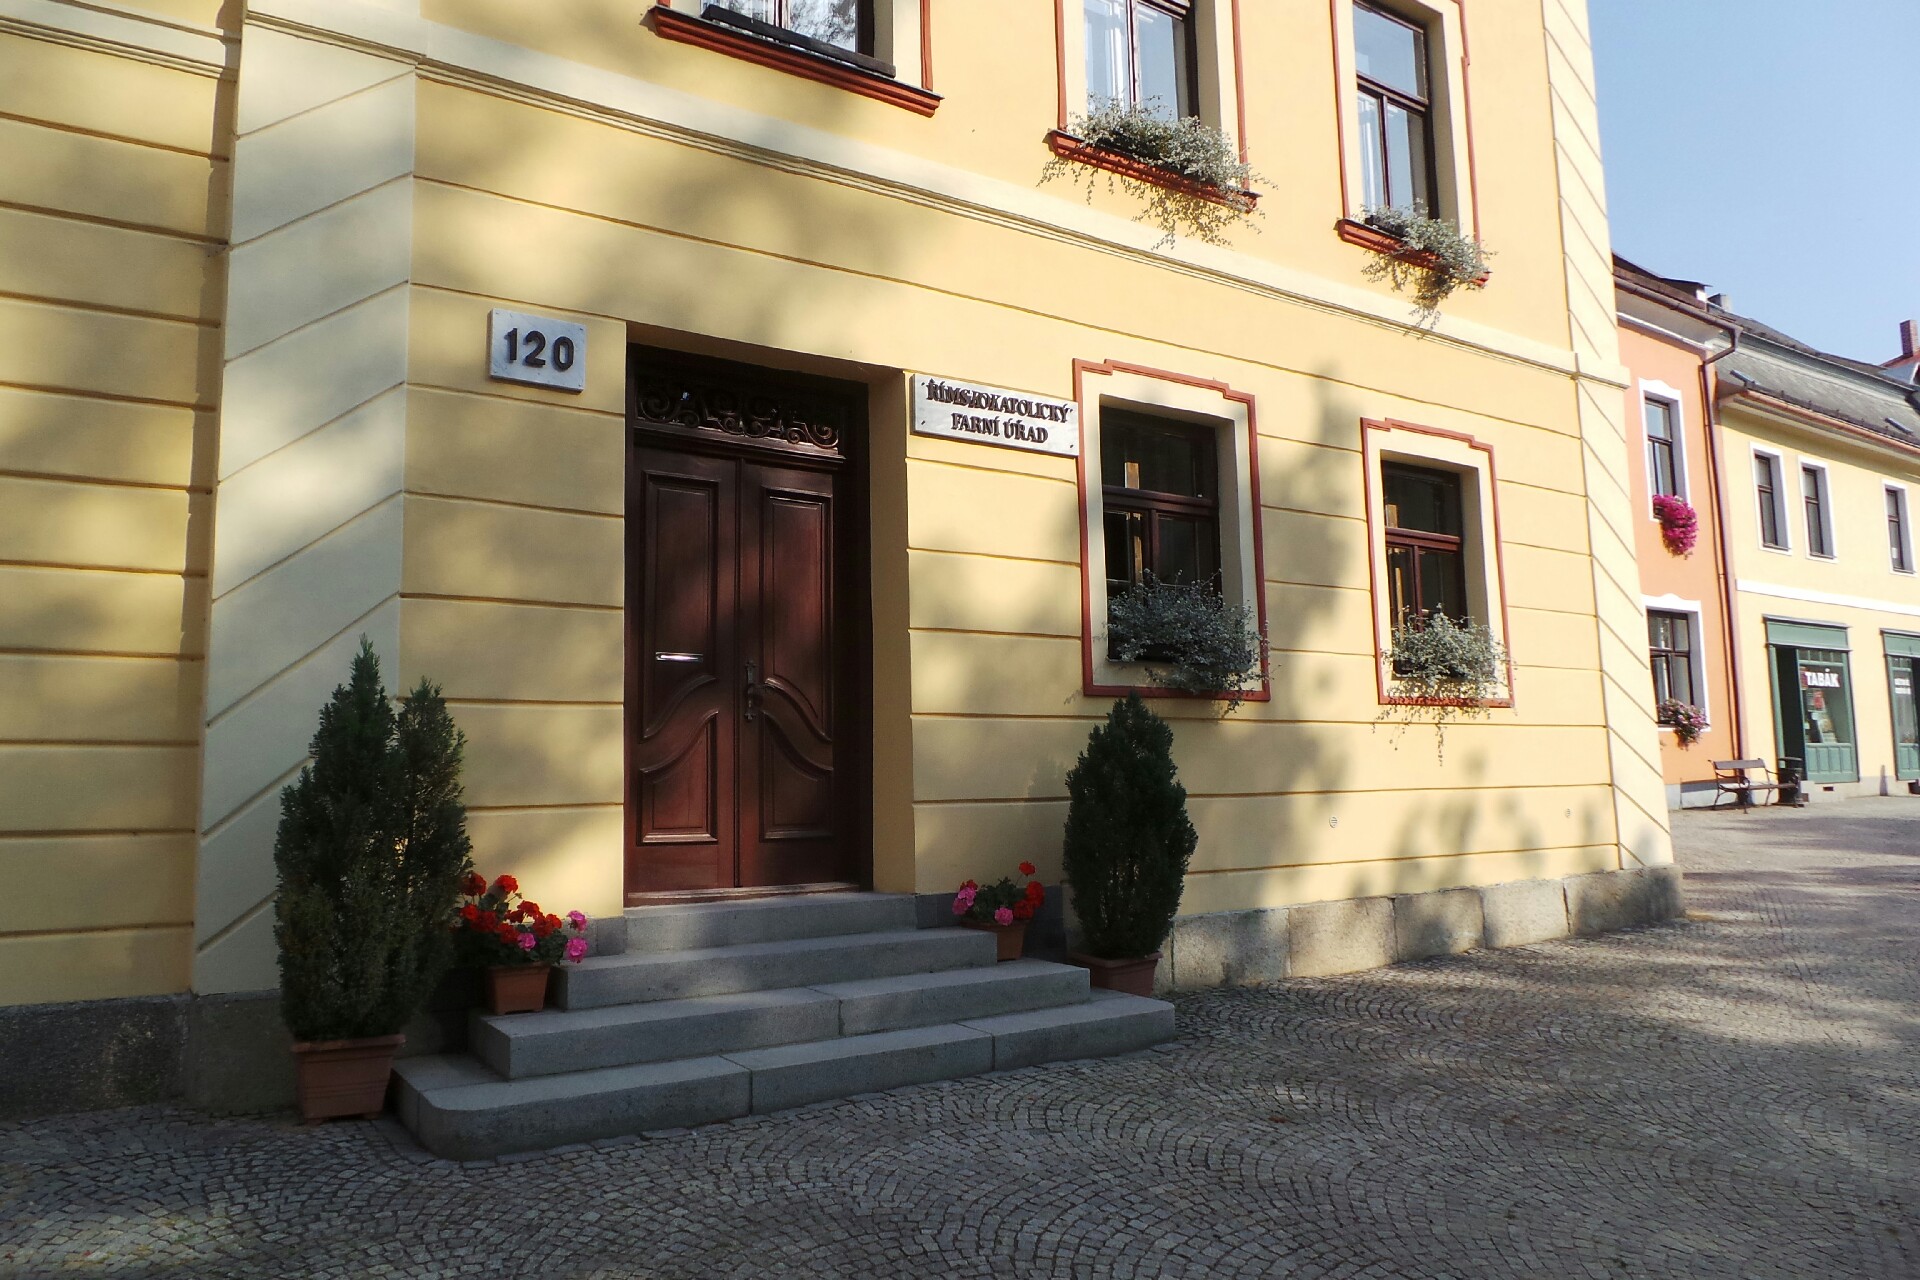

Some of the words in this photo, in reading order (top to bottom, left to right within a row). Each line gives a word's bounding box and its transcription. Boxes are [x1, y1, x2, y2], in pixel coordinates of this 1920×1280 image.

[504, 328, 574, 371] 120
[926, 378, 1070, 423] ŘÍMSKOKATOLICKÝ
[951, 413, 1000, 437] FARNÍ
[1003, 418, 1048, 443] ÚŘAD
[1804, 668, 1840, 688] TABÁK
